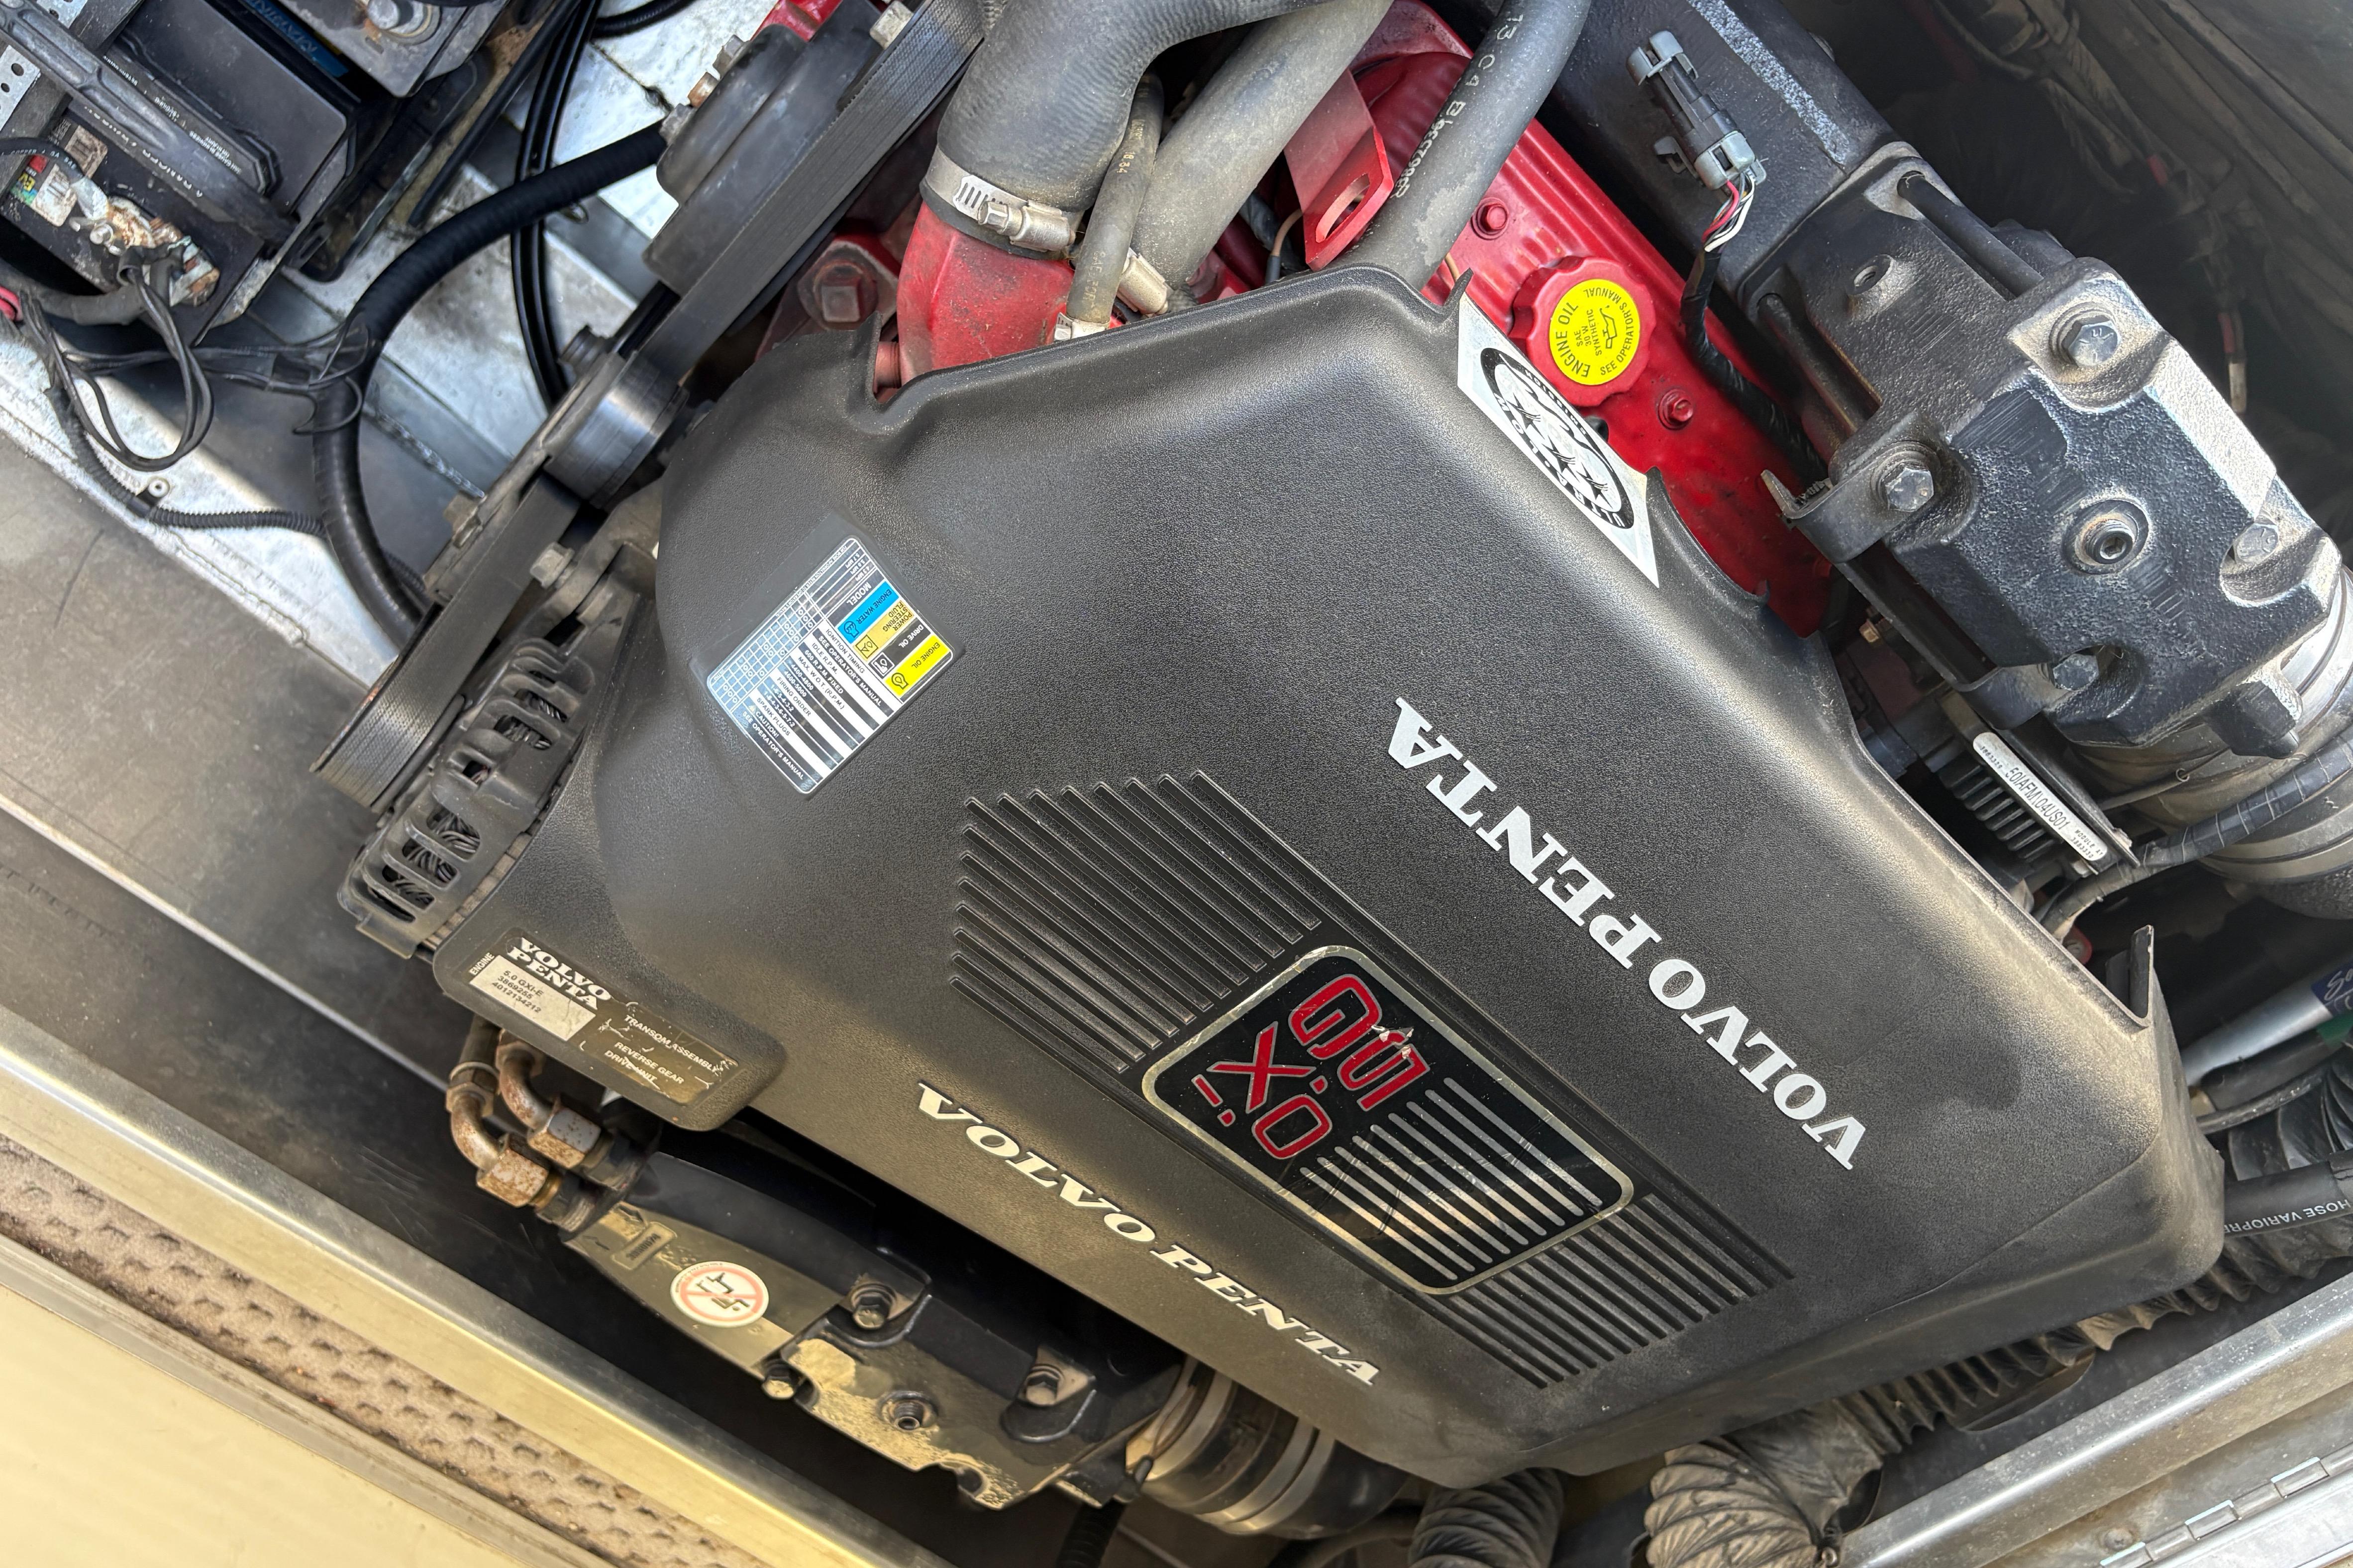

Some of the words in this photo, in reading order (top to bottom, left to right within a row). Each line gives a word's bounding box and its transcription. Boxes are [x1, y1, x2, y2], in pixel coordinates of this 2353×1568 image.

[1583, 287, 1622, 304] MANUAL
[1558, 302, 1578, 325] OIL
[1574, 330, 1583, 347] SAE
[1585, 336, 1592, 346] 30
[1586, 309, 1602, 356] SYNTHETIC
[1616, 302, 1634, 363] OPERATOR'S
[1556, 331, 1590, 378] ENGINE
[1600, 360, 1617, 376] SEE
[1524, 369, 1587, 435] EMISSION
[1493, 392, 1539, 455] LOW
[1555, 471, 1626, 527] ULTRA
[844, 559, 854, 568] MPI
[849, 565, 859, 575] MPI
[854, 571, 864, 581] MPI
[846, 582, 871, 607] MODEL
[872, 588, 892, 608] ENGINE
[856, 605, 874, 624] WATER
[882, 606, 908, 632] STEERING
[887, 601, 903, 617] FLUID
[892, 611, 912, 631] POWER
[898, 638, 909, 649] OIL
[907, 624, 923, 641] DRIVE
[810, 642, 824, 657] IDLE
[821, 656, 839, 675] R.P.M.
[824, 628, 849, 655] IGNITION
[846, 653, 866, 674] TIMING
[911, 658, 921, 670] OIL
[920, 642, 940, 662] ENGINE
[782, 670, 808, 697] 4600-5000
[789, 663, 815, 690] 4400-4800
[797, 656, 812, 672] MAX.
[809, 670, 827, 689] W.O.T.
[824, 687, 845, 710] (R.P.M.)
[803, 649, 815, 661] 600
[812, 659, 829, 678] R.P.M.
[827, 676, 844, 694] FIXED
[818, 635, 831, 649] SEE
[827, 646, 862, 684] OPERATOR'S
[859, 681, 883, 707] MANUAL
[776, 677, 795, 697] FIRING
[792, 695, 812, 716] ORDER
[754, 710, 780, 738] CAUTION!
[755, 697, 775, 717] SPARK
[772, 716, 791, 736] PLUGS
[741, 710, 754, 724] SEE
[751, 722, 784, 758] OPERATOR'S
[782, 756, 805, 781] MANUAL
[1388, 696, 1662, 969] PENTA
[470, 952, 495, 976] ENGINE
[519, 937, 611, 1001] VOLVO
[497, 974, 533, 1000] 3869255
[503, 969, 517, 981] 5.0
[517, 978, 544, 998] GXI-E
[507, 945, 599, 1011] PENTA
[491, 979, 542, 1014] 4012134212
[623, 1014, 671, 1046] TRANSOM
[670, 1042, 718, 1074] ASSEMBLY
[604, 1049, 634, 1070] DRIVE
[613, 1041, 658, 1070] REVERSE
[656, 1065, 685, 1084] GEAR
[1648, 958, 1866, 1171] VOLVO
[2303, 1198, 2351, 1217] HOSE
[918, 1082, 1156, 1242] VOLVO
[1149, 1243, 1381, 1386] PENTA
